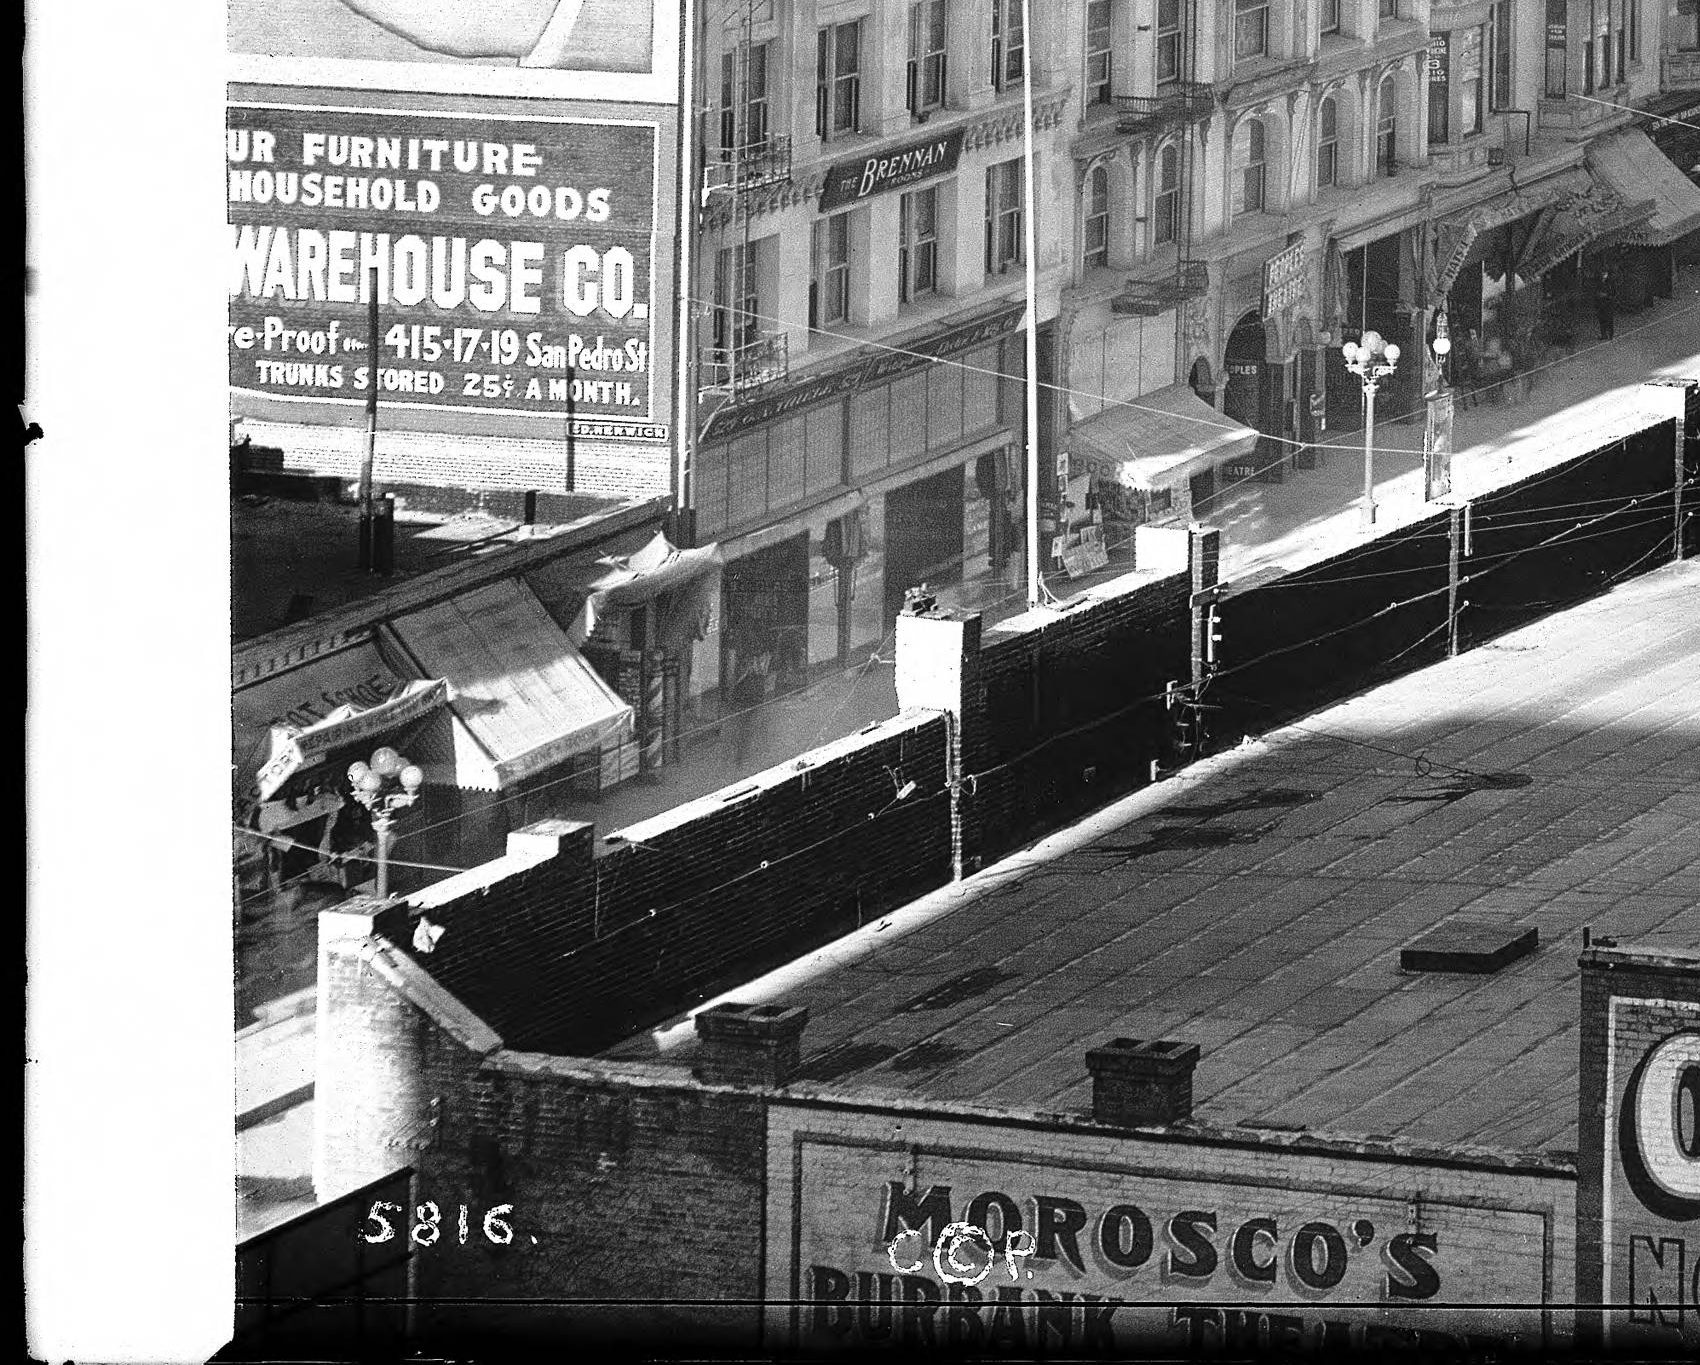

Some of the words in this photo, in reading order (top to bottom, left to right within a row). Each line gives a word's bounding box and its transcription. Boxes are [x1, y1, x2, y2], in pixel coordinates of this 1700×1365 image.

[302, 133, 542, 175] FURNITURE
[858, 141, 948, 197] BRENNAN
[230, 171, 441, 213] HOUSEHOLD
[471, 186, 611, 221] GOODS
[230, 225, 544, 314] WAREHOUSE
[562, 244, 648, 318] CO.
[256, 360, 343, 388] TRUNKS
[353, 367, 444, 394] STORED
[526, 378, 541, 401] A
[549, 378, 640, 406] MONTH.
[882, 1181, 1441, 1301] MOROSCO'S
